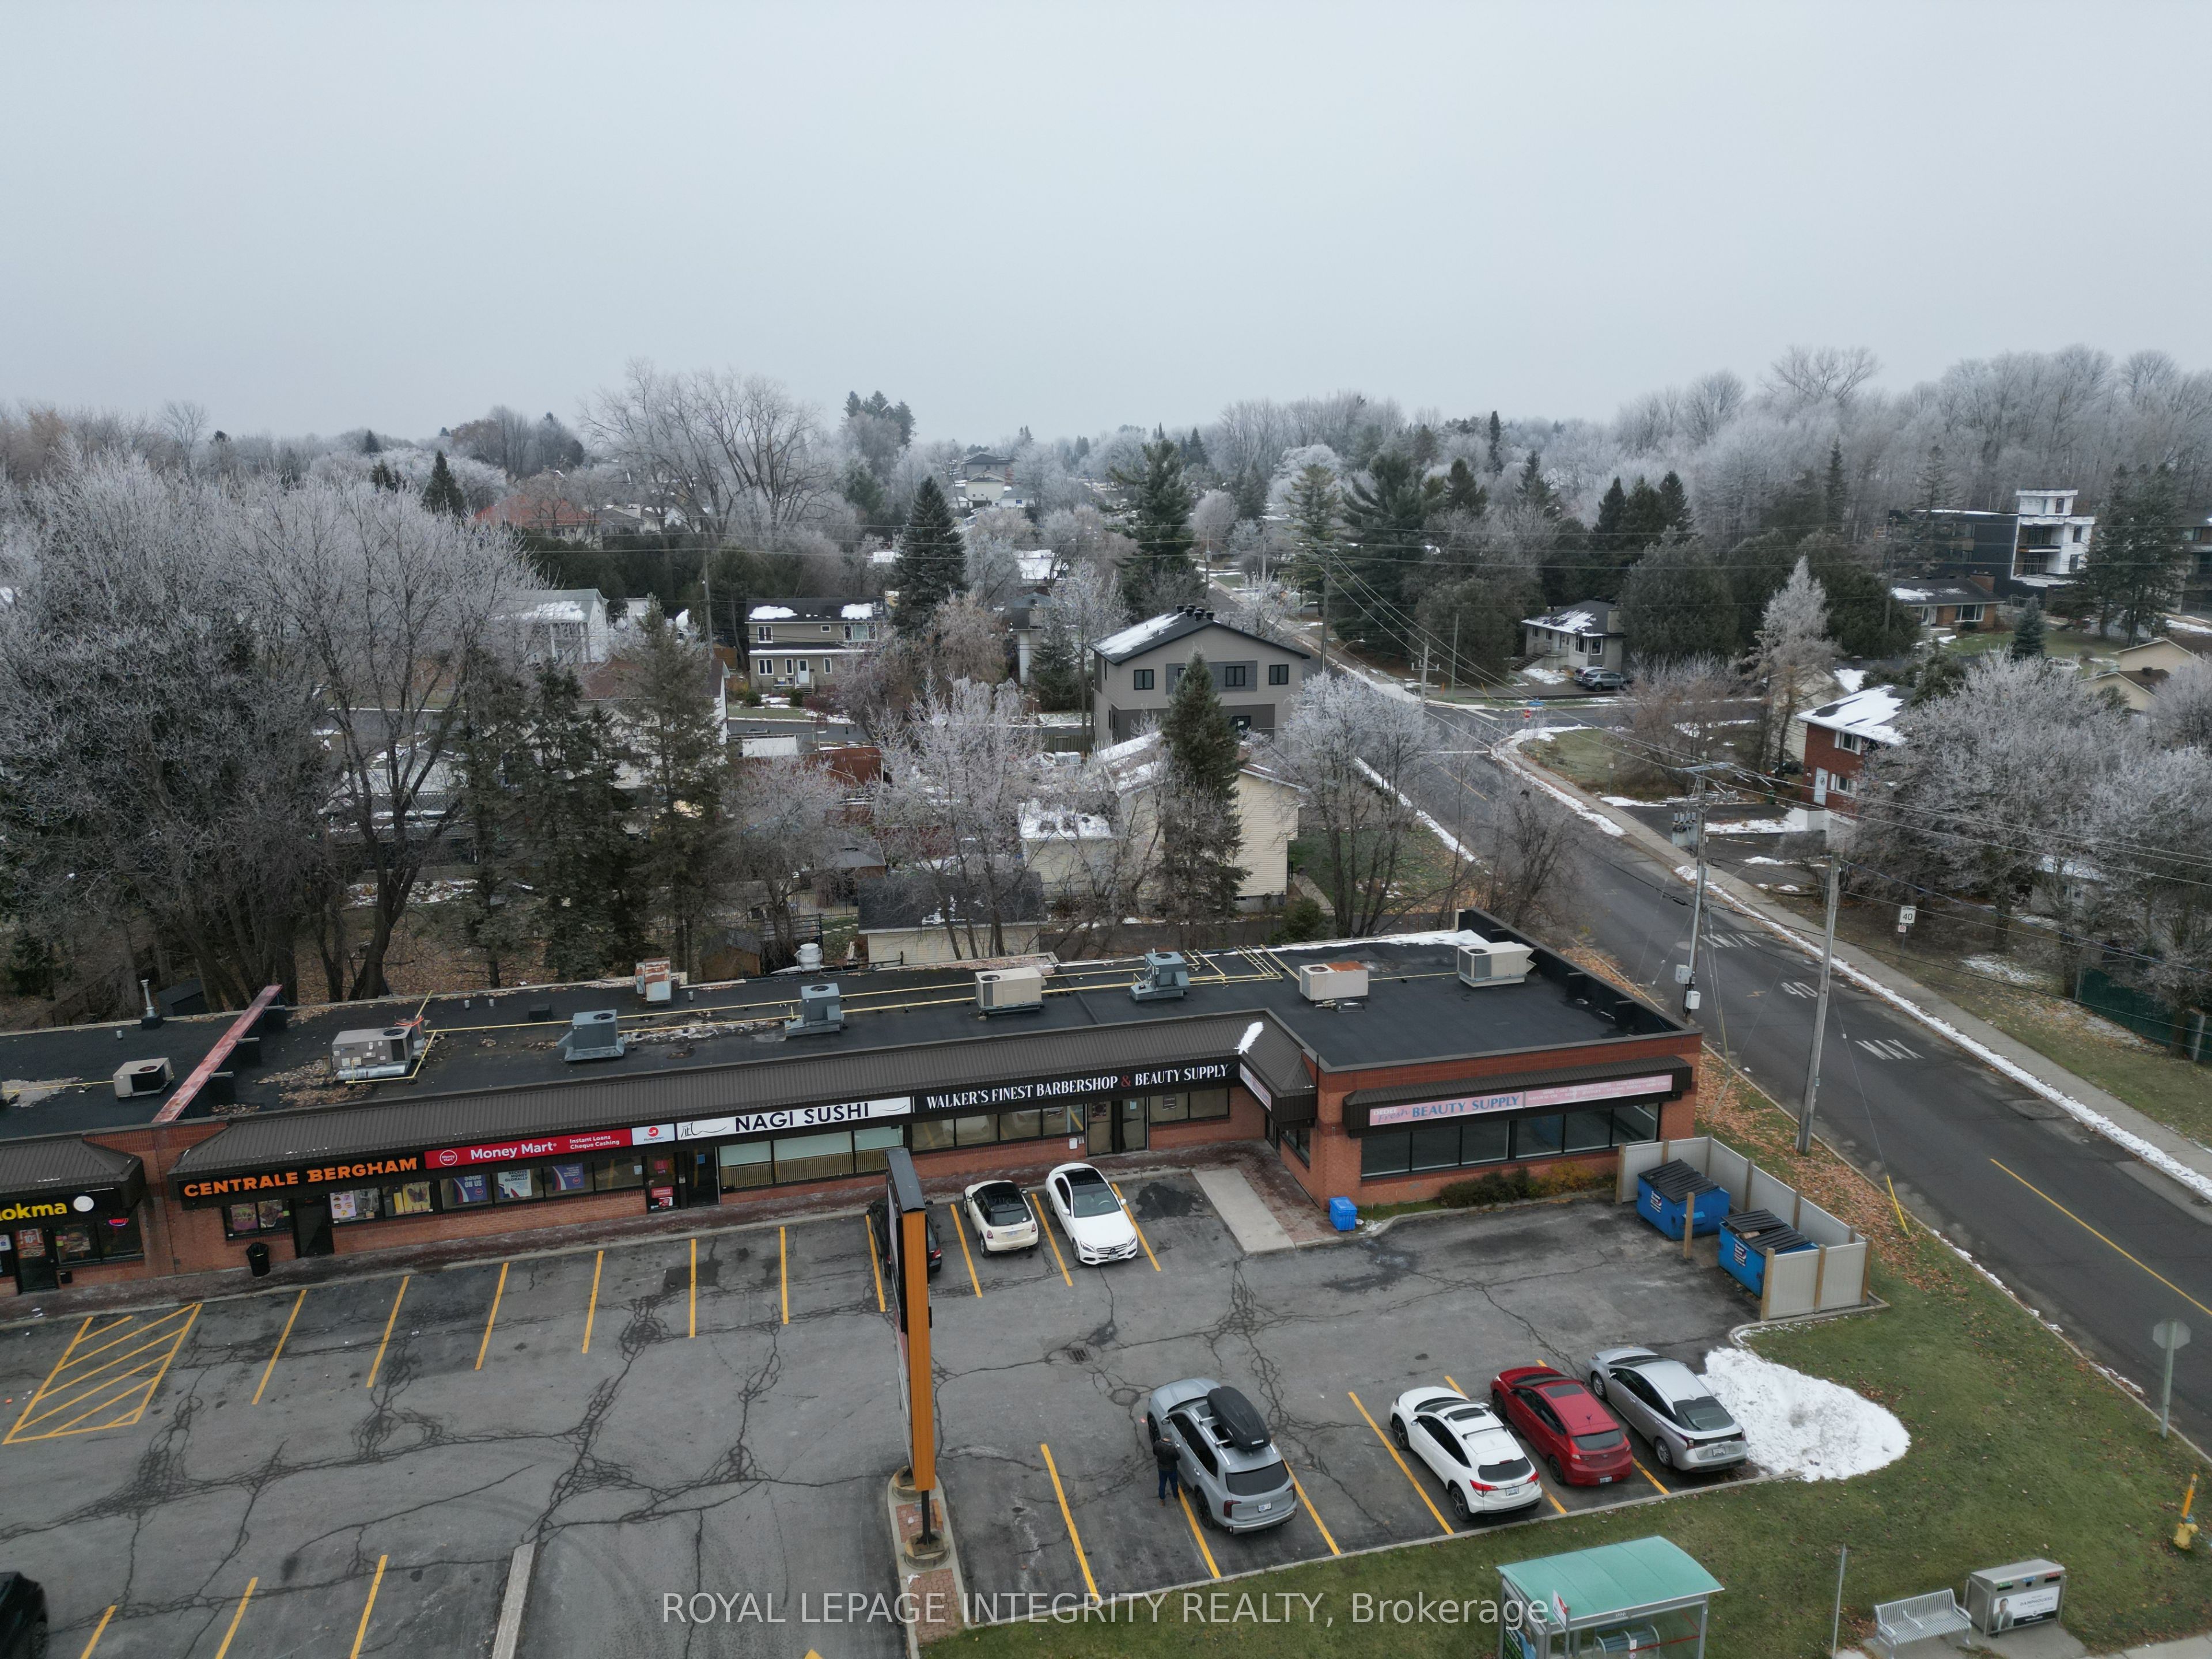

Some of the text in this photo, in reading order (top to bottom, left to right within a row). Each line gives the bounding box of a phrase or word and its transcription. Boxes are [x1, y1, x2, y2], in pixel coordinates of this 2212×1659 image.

[1781, 982, 1818, 999] 40
[927, 1064, 1228, 1109] WALKER'S FINEST BARBERSHOP & BEAUTY SUPPLY
[736, 1103, 869, 1132] NAGI SUSHI
[1378, 1095, 1521, 1123] Fresh BEAUTY SUPPLY
[471, 1142, 554, 1160] Money Mart
[184, 1157, 418, 1197] CENTRALE BERGHAM
